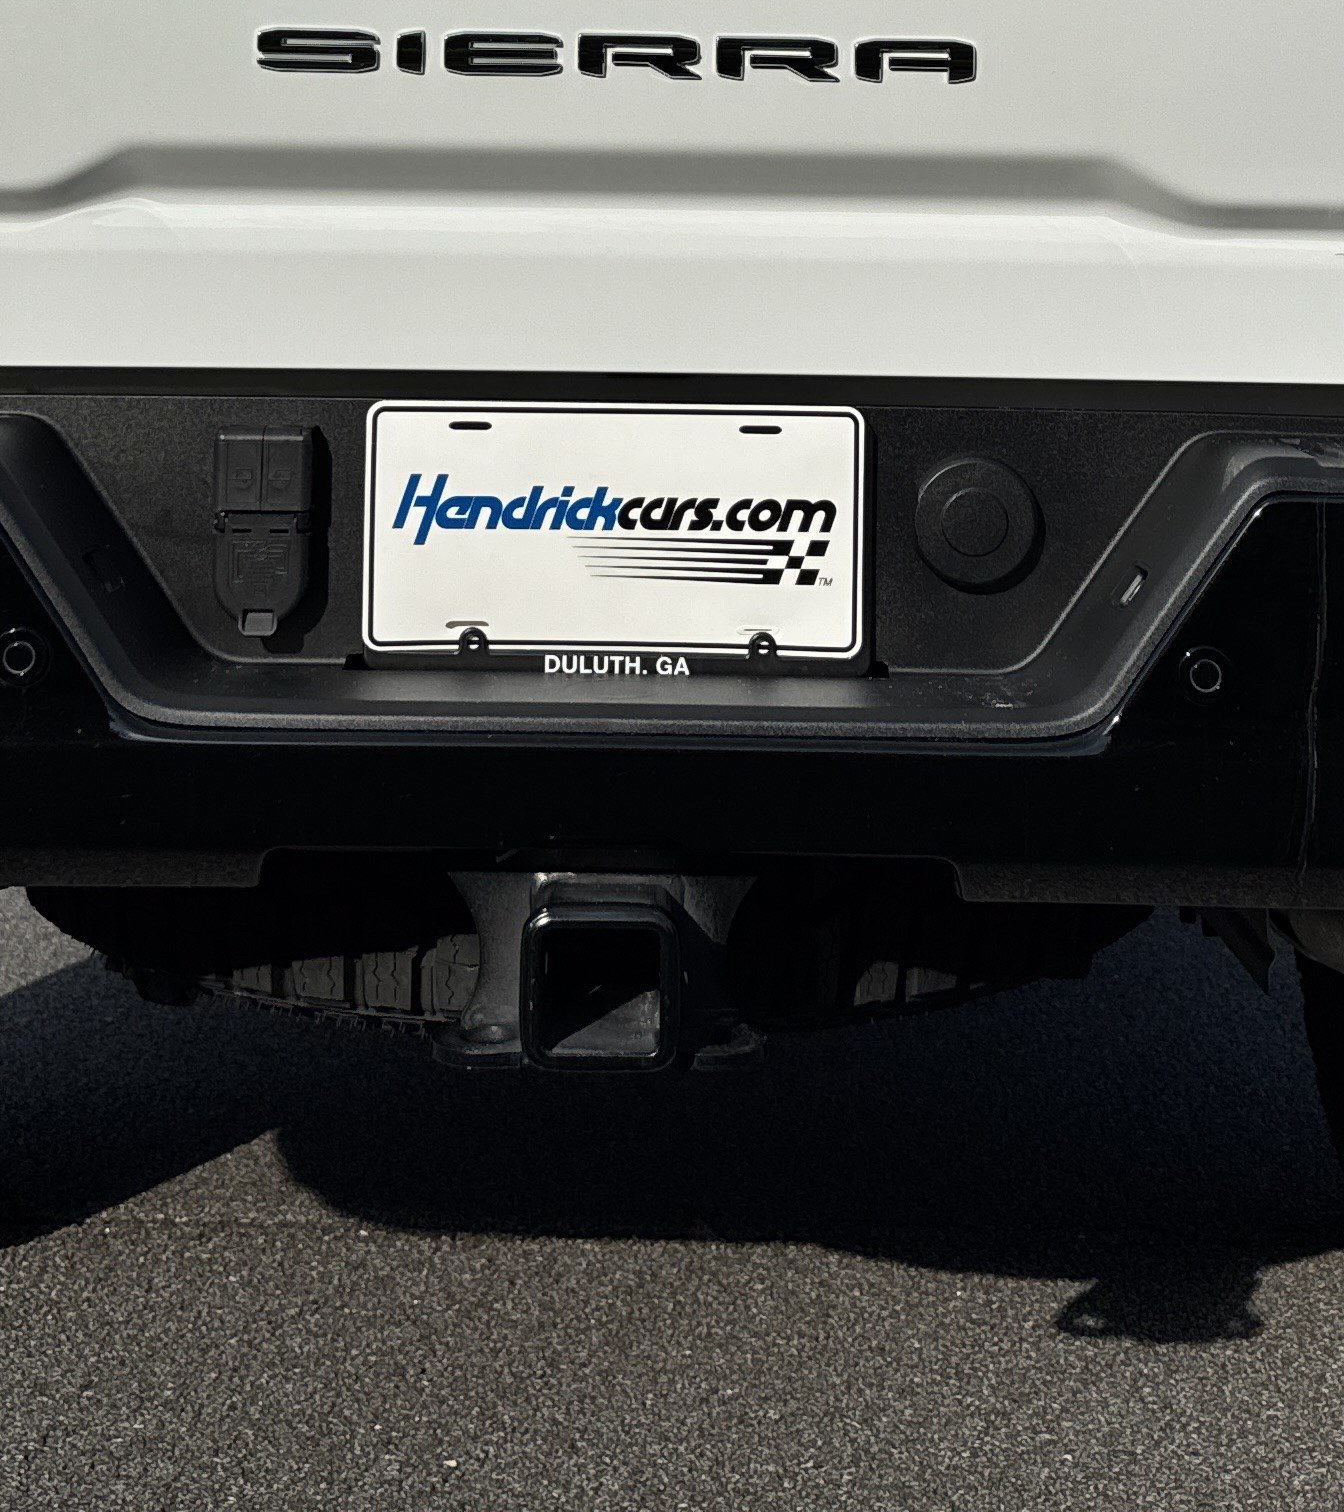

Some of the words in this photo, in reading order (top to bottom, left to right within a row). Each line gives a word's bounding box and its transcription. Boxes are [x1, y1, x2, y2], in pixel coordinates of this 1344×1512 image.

[256, 28, 977, 83] SIERRA
[392, 473, 837, 545] Hendrickcars.com
[818, 577, 833, 586] TM
[656, 655, 690, 676] GA
